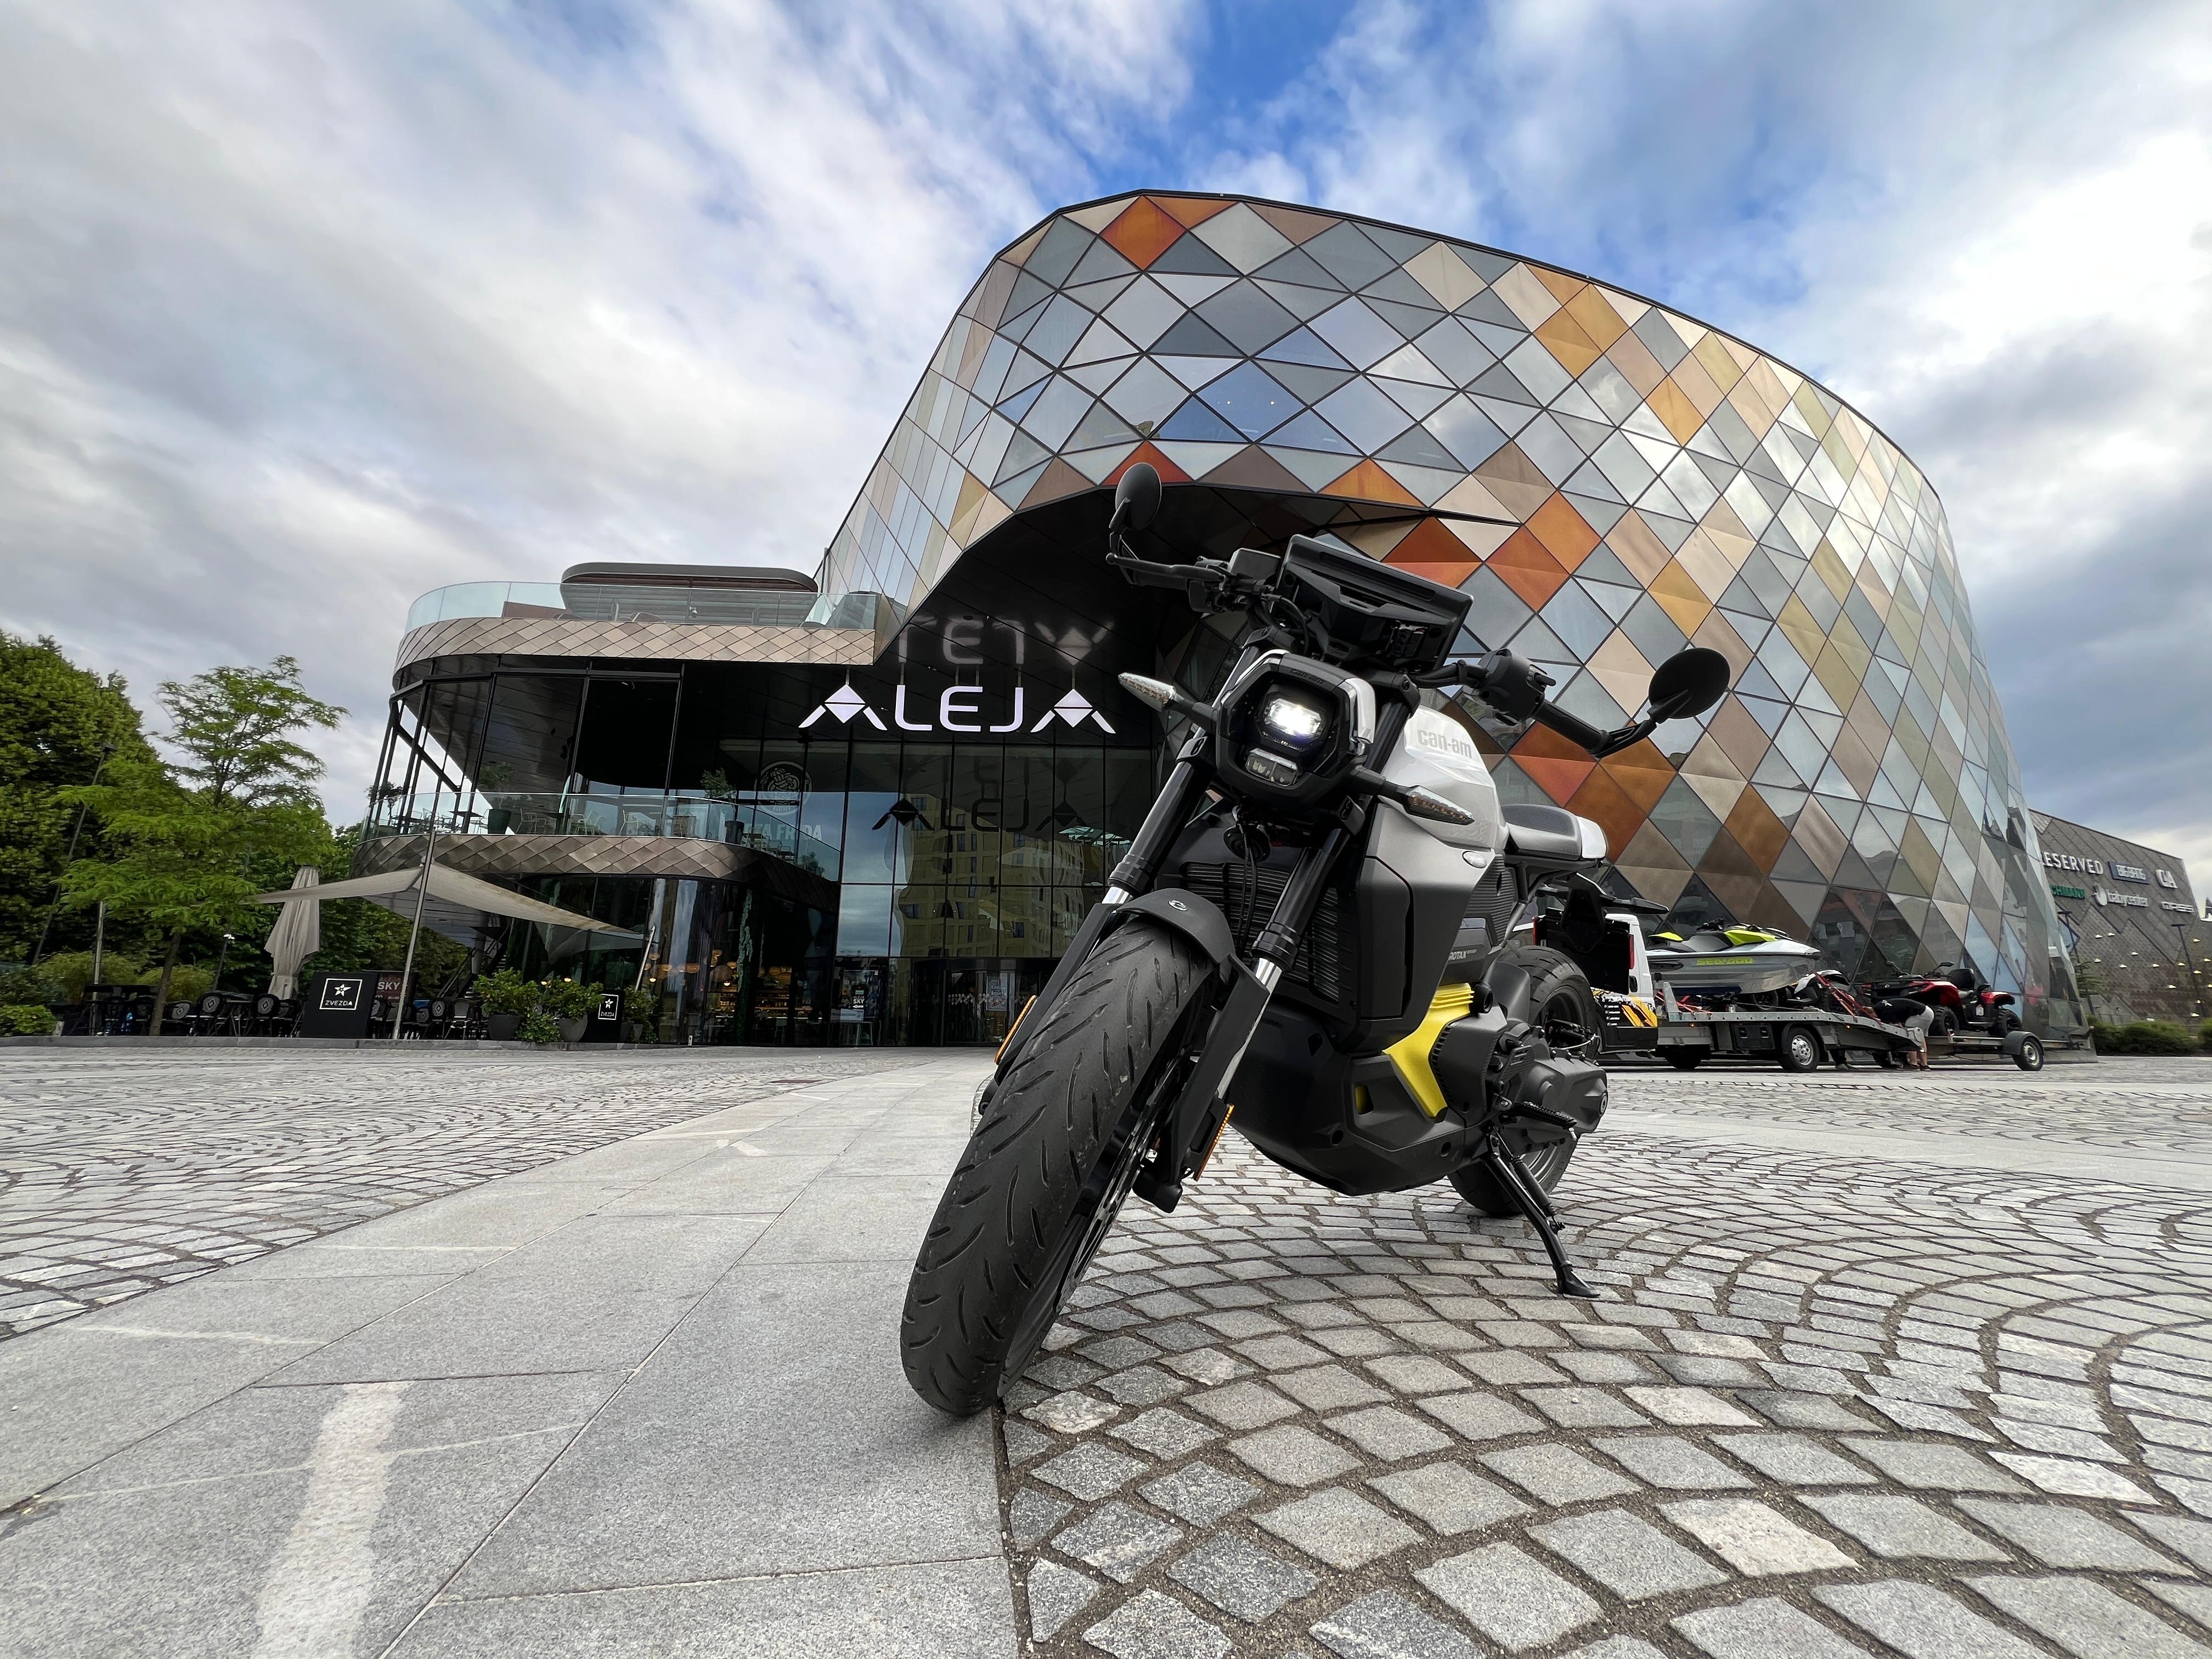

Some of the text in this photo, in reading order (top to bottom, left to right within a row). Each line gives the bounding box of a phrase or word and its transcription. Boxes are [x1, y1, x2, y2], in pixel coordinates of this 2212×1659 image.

[798, 684, 1116, 733] ALEJA
[1417, 729, 1472, 759] can-am
[776, 824, 822, 840] FRDA
[2041, 851, 2104, 875] ESERVED
[377, 981, 400, 990] SKY
